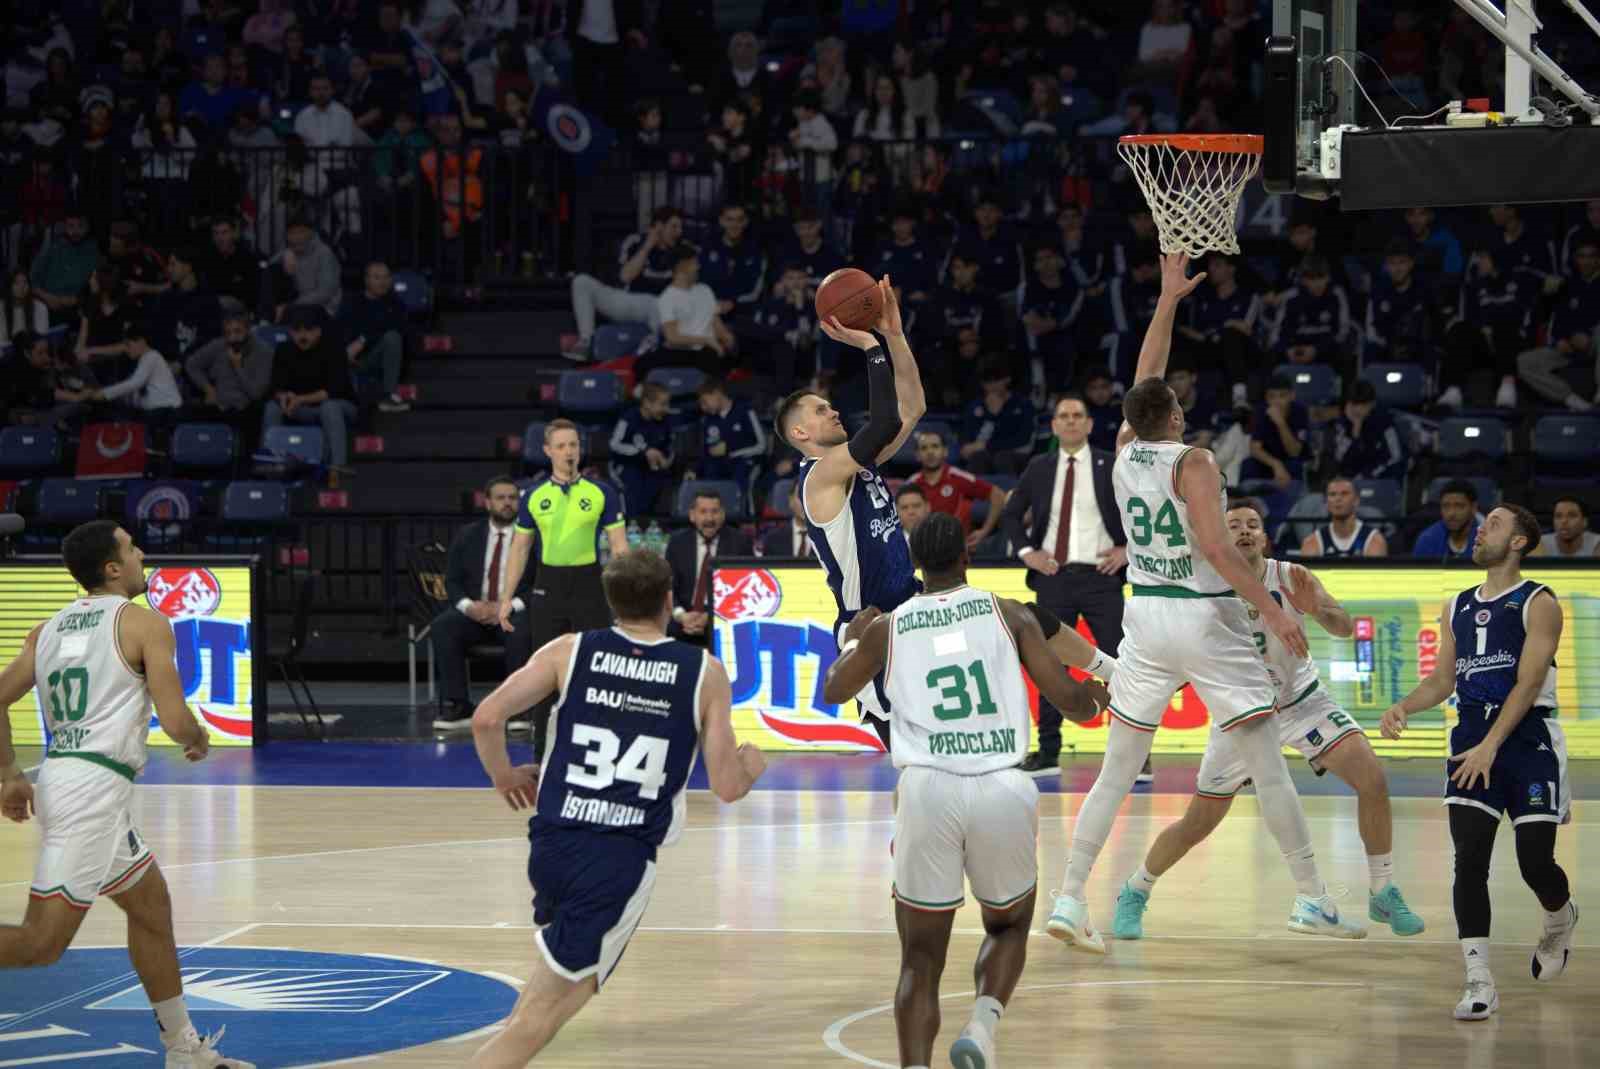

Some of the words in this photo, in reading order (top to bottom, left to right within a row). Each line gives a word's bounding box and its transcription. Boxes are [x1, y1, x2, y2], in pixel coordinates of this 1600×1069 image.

[1127, 496, 1186, 547] 34
[897, 598, 994, 635] COLEMAN-JONES
[1475, 627, 1487, 656] 1
[590, 651, 678, 684] CAVANAUGH
[48, 667, 89, 721] 10
[585, 687, 623, 708] BAU
[926, 659, 998, 721] 31
[564, 723, 670, 800] 34
